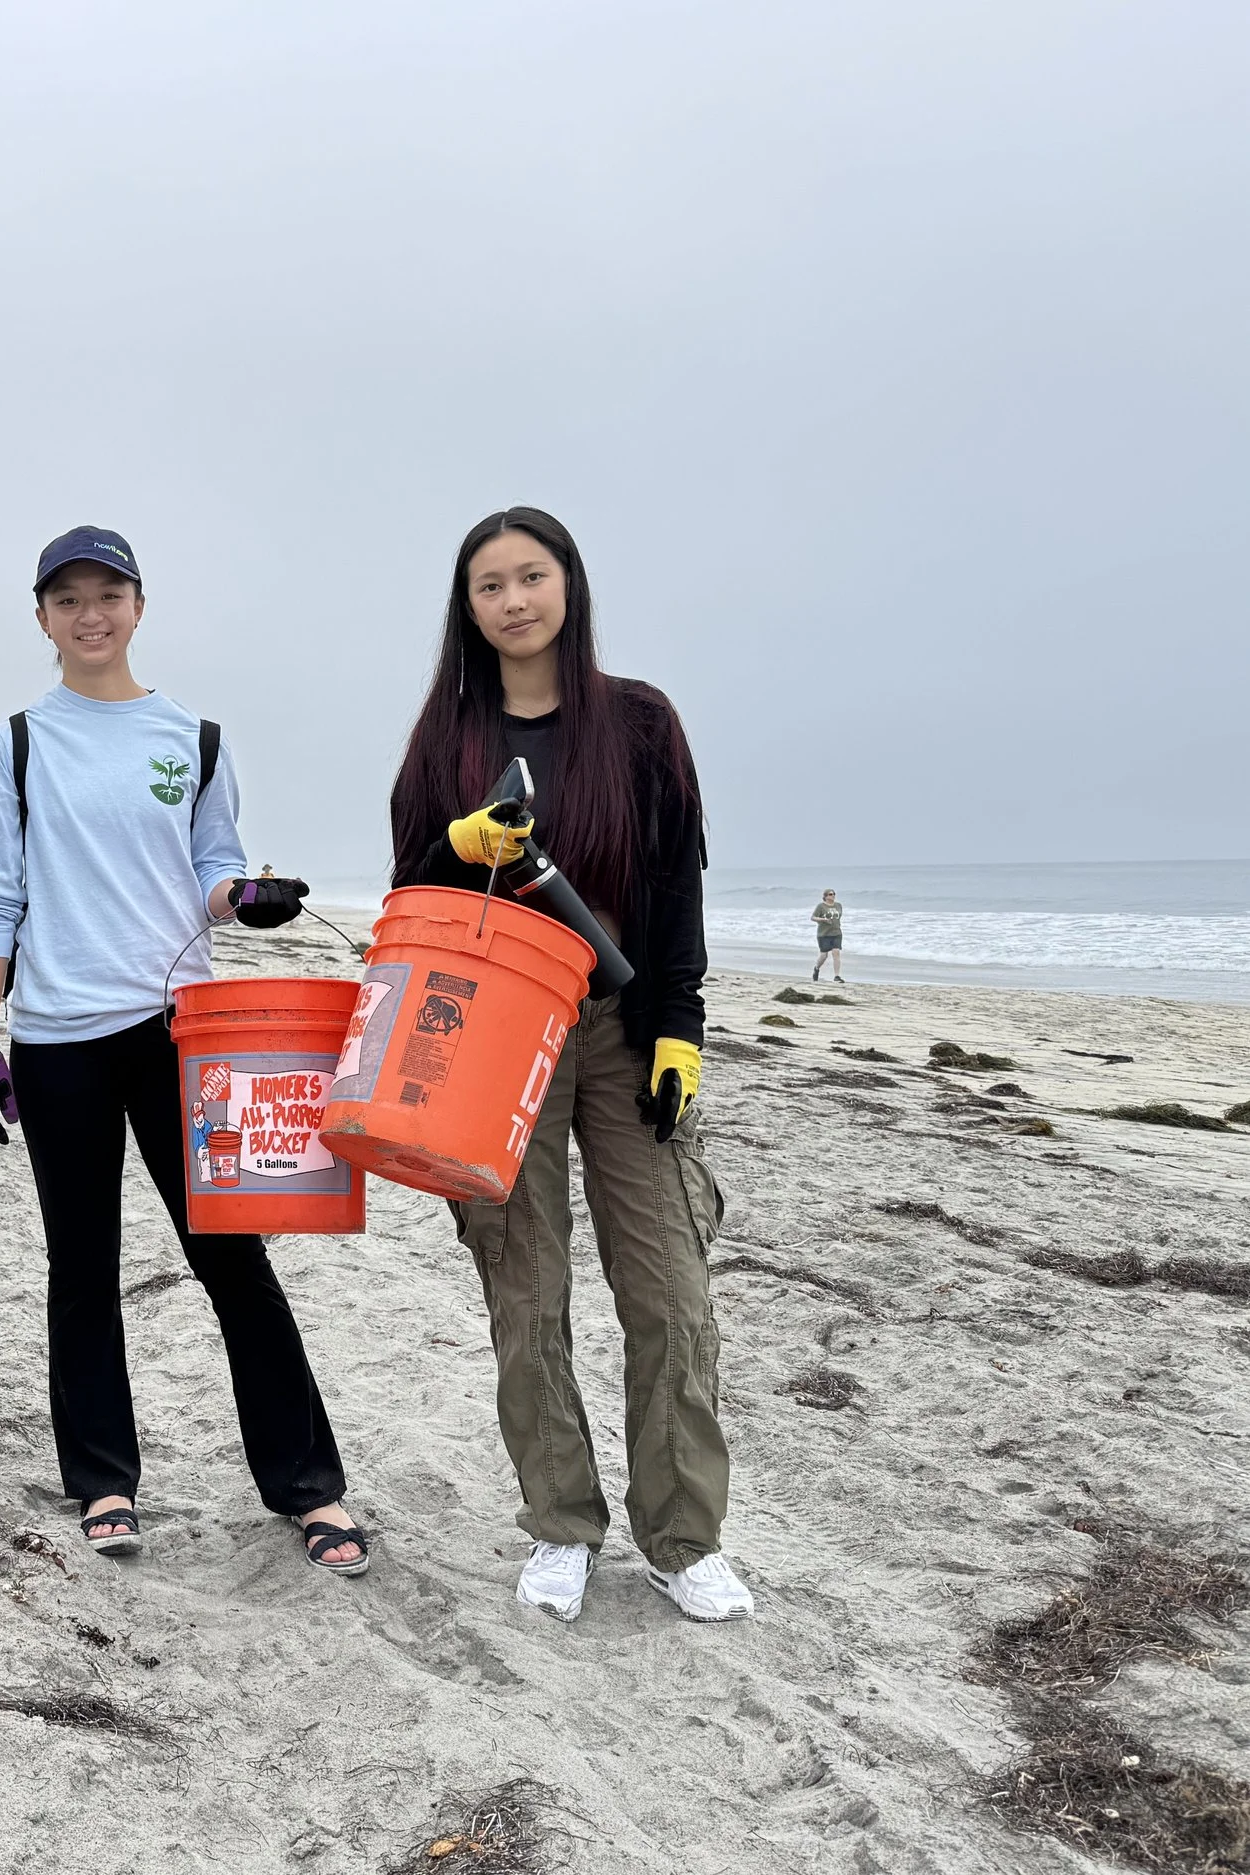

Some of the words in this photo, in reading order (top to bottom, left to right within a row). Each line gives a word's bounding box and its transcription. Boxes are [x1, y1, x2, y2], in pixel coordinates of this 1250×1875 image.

[201, 1062, 230, 1102] HOME
[203, 1066, 216, 1083] THE
[211, 1074, 230, 1101] DEPOT
[251, 1074, 323, 1106] HOMER'S
[249, 1130, 312, 1156] BUCKET
[256, 1159, 263, 1169] 5
[264, 1158, 299, 1169] Gallons
